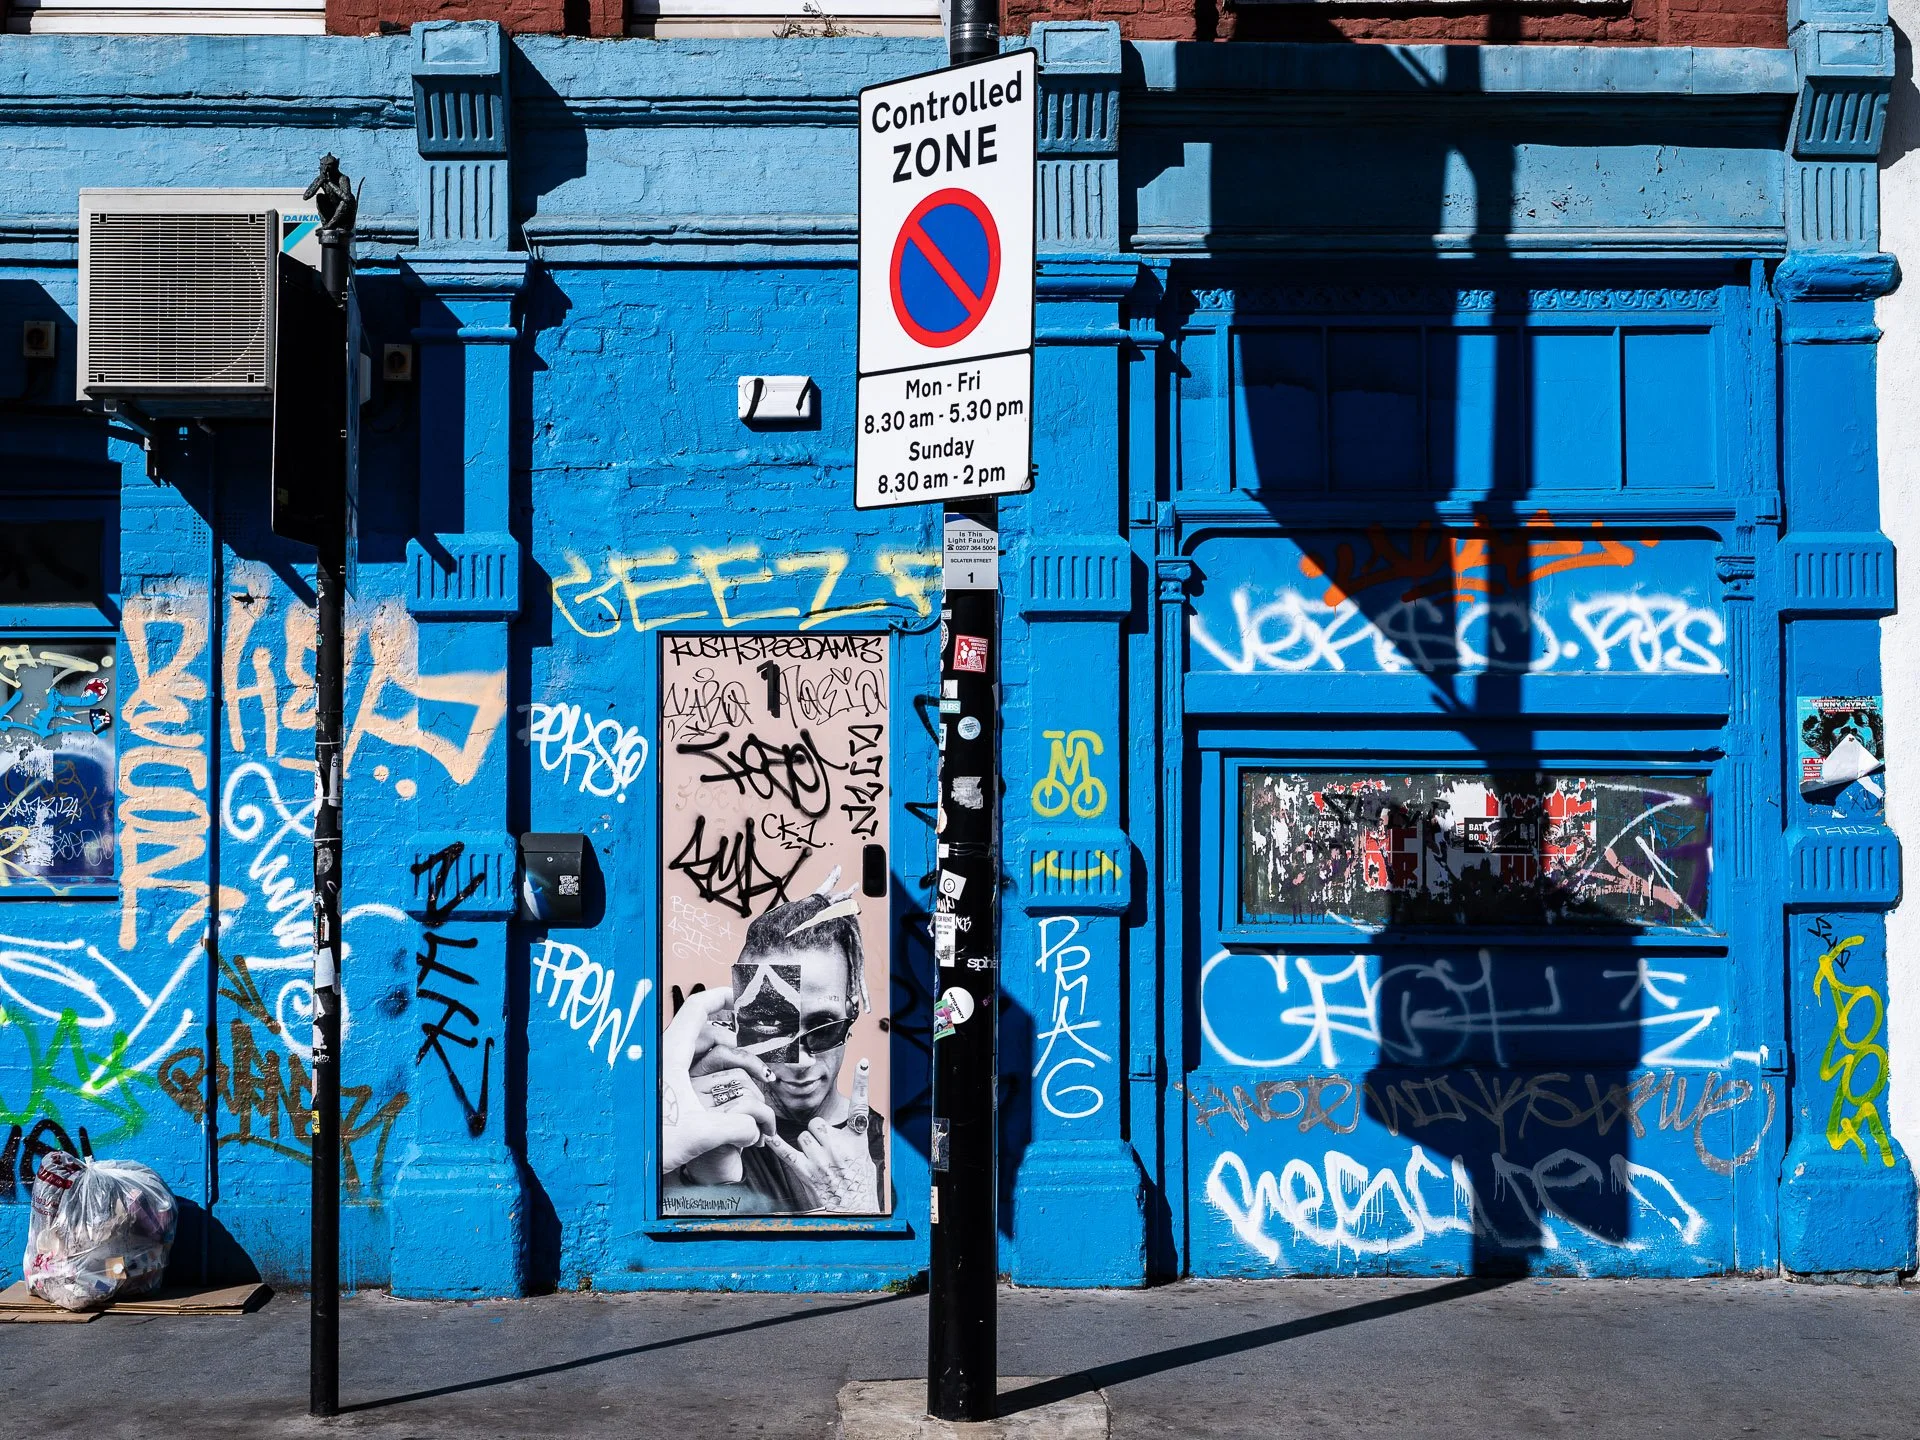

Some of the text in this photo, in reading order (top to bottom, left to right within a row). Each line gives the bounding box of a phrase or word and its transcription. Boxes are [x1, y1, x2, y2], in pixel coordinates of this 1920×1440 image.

[872, 70, 1023, 134] Controlled
[893, 124, 998, 184] ZONE
[906, 378, 943, 399] Mon
[958, 371, 981, 393] Fri
[864, 412, 905, 434] 8.30
[909, 412, 934, 428] am
[949, 400, 992, 425] 5.30
[997, 399, 1024, 422] pm
[909, 437, 975, 461] Sunday
[878, 469, 919, 495] 8.30
[922, 471, 949, 488] am
[963, 464, 974, 485] 2
[978, 465, 1006, 489] pm
[967, 572, 974, 583] 1
